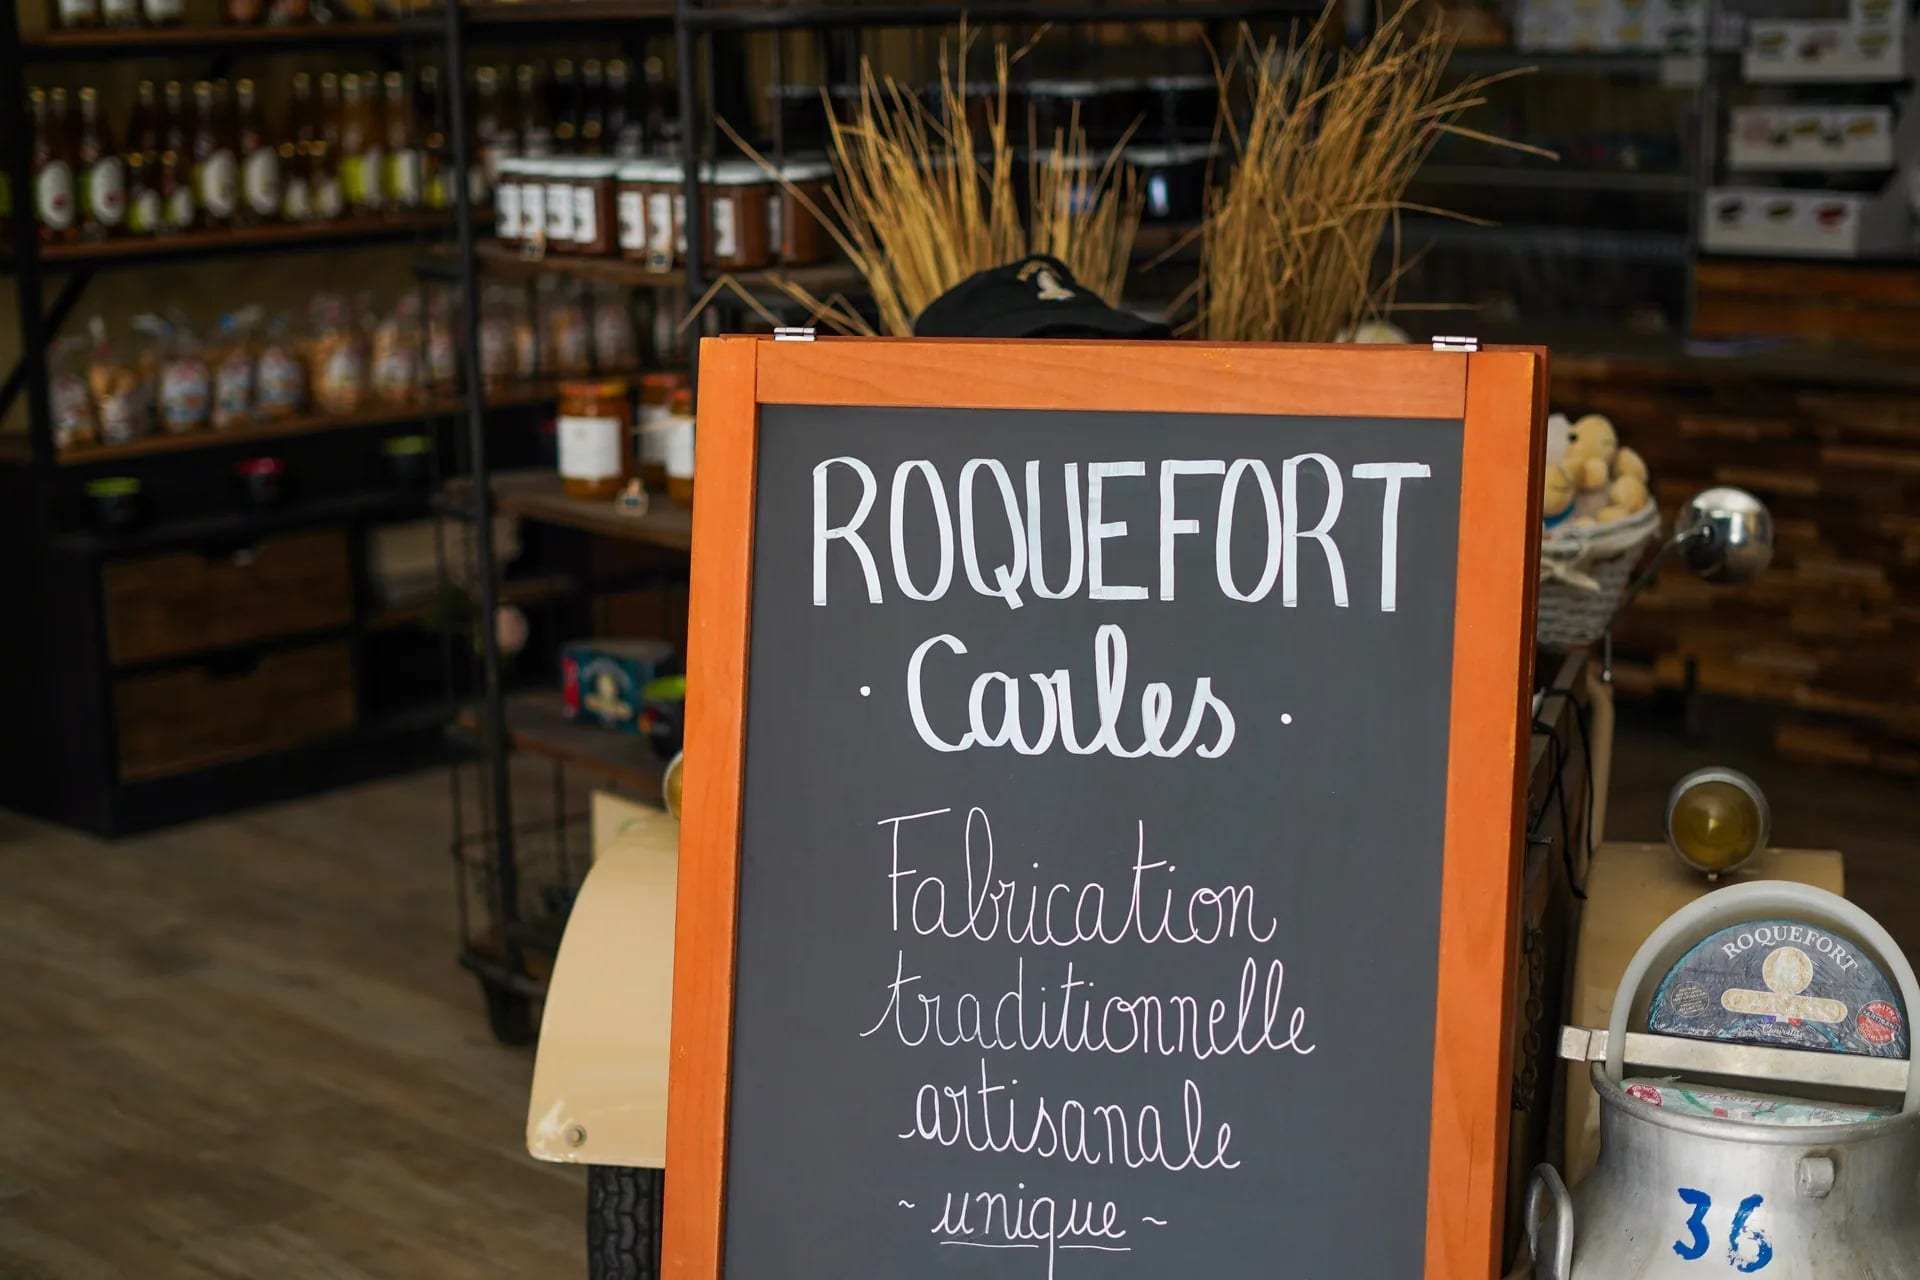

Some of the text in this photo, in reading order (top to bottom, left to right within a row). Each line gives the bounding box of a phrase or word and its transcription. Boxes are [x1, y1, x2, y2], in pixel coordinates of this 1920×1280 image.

[813, 453, 1431, 611] ROQUEFORT
[907, 624, 1236, 758] Carles
[878, 807, 1277, 946] Fabrication
[1721, 925, 1860, 972] ROQUEFORT
[860, 950, 1316, 1060] traditionnelle
[899, 1058, 1241, 1171] artisanale
[931, 1183, 1127, 1280] unique
[1673, 1187, 1773, 1273] 36
